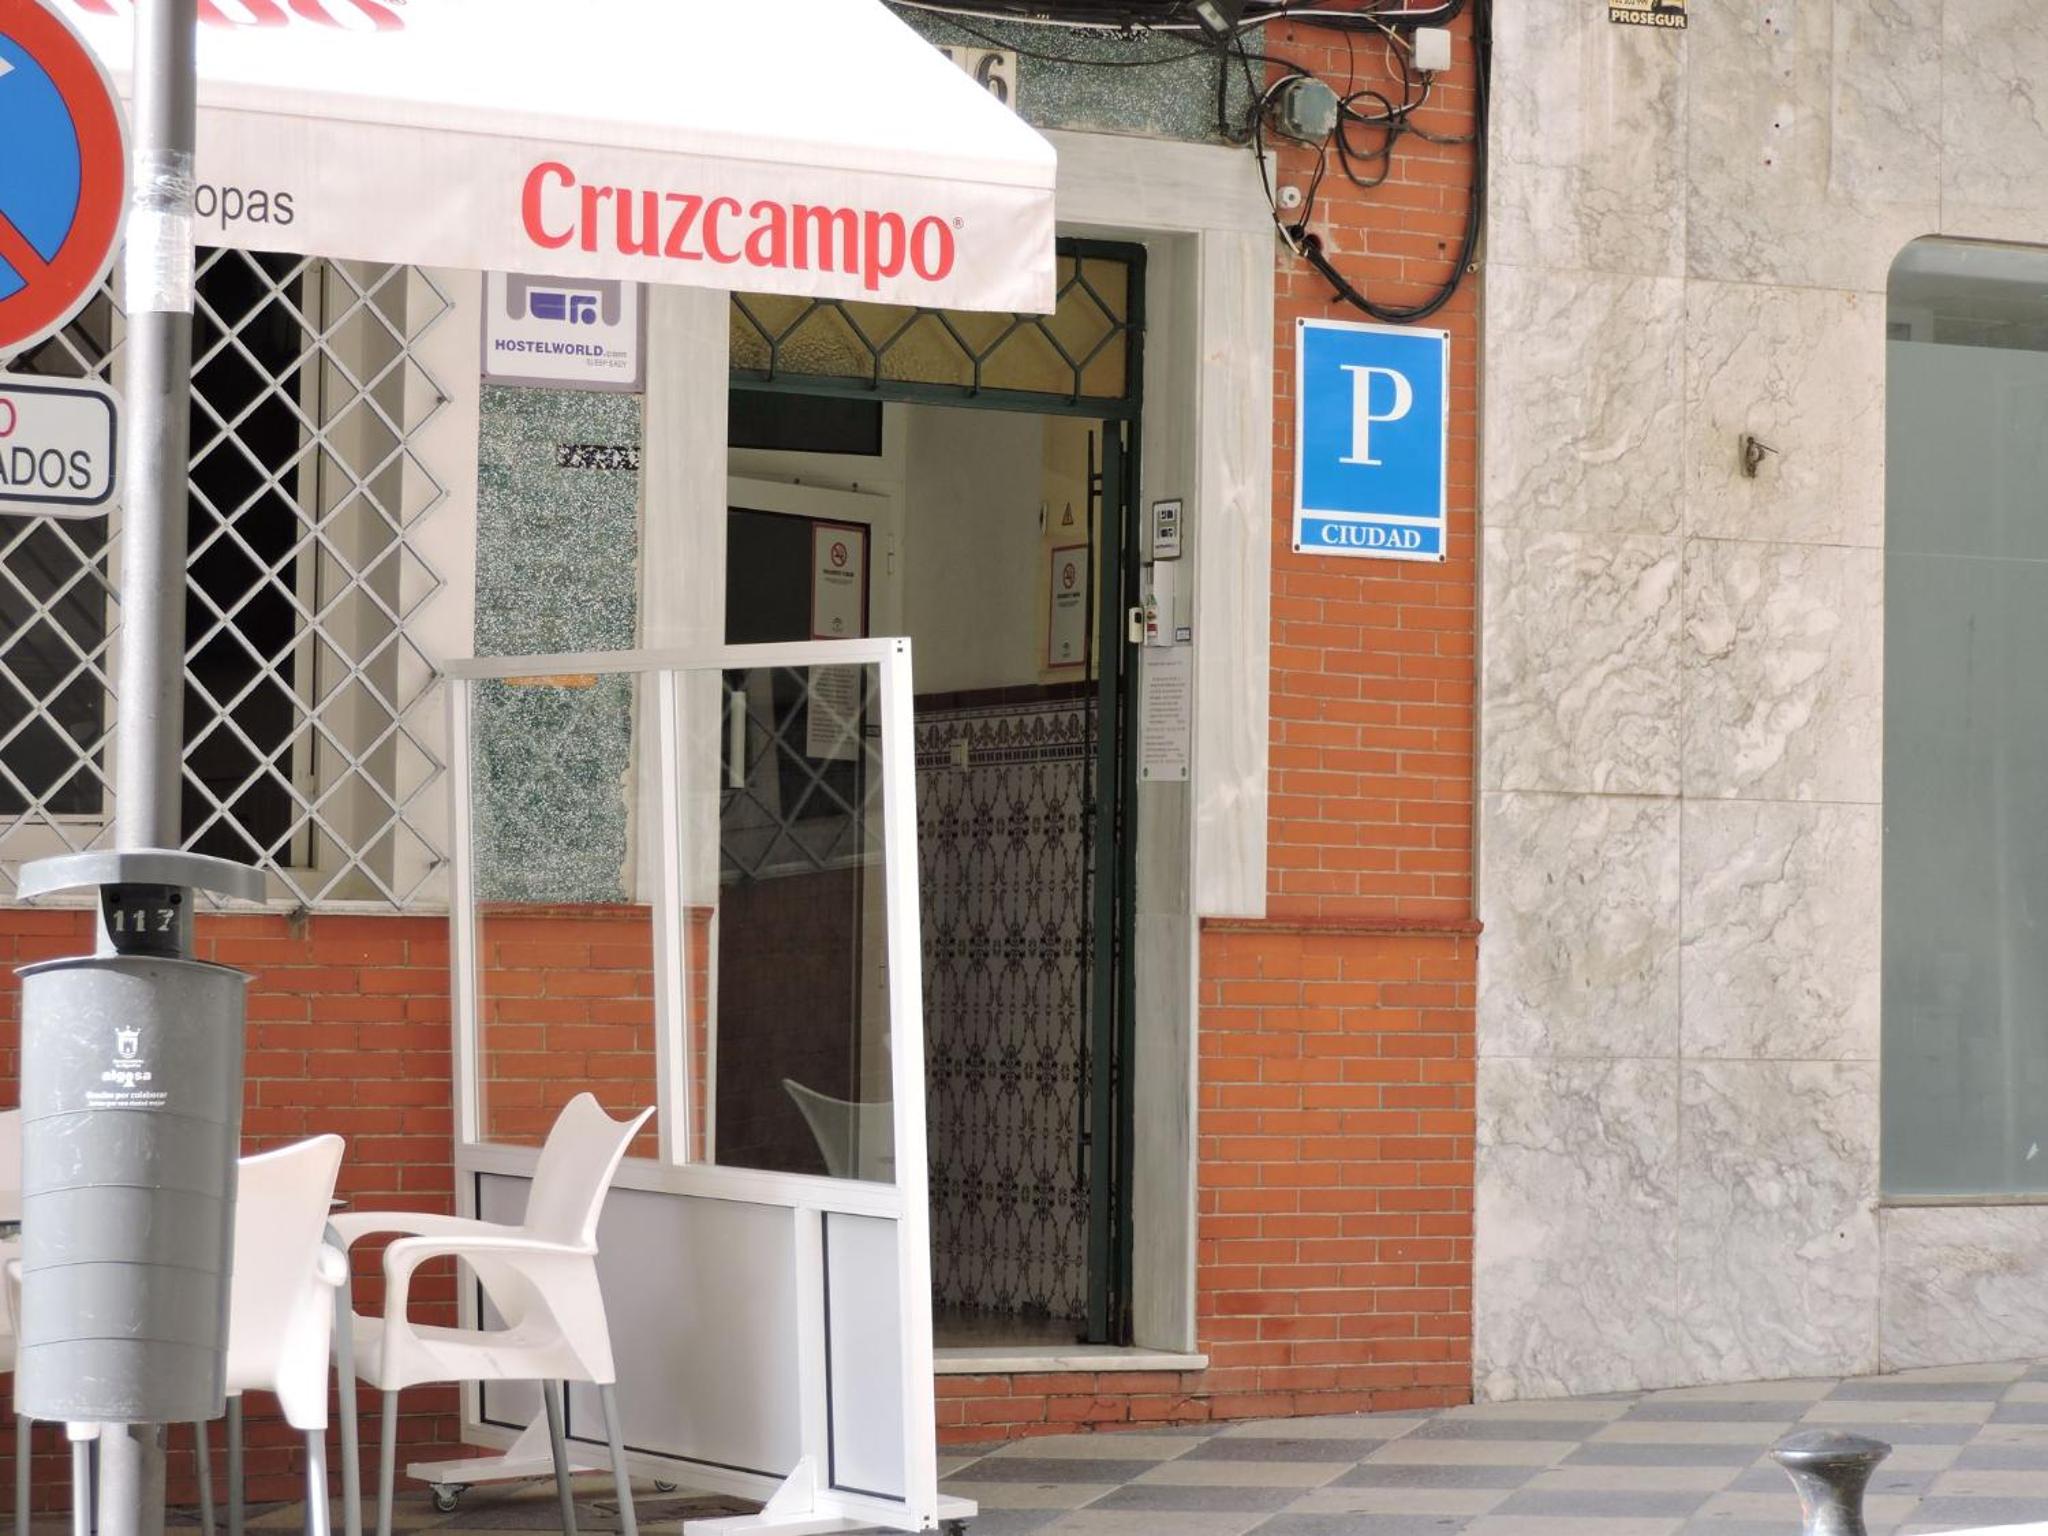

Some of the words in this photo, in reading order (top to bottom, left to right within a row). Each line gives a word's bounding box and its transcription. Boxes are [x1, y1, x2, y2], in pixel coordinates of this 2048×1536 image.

[1611, 9, 1686, 28] PROSEGUR
[1338, 363, 1414, 466] P
[1320, 523, 1421, 549] CIUDAD
